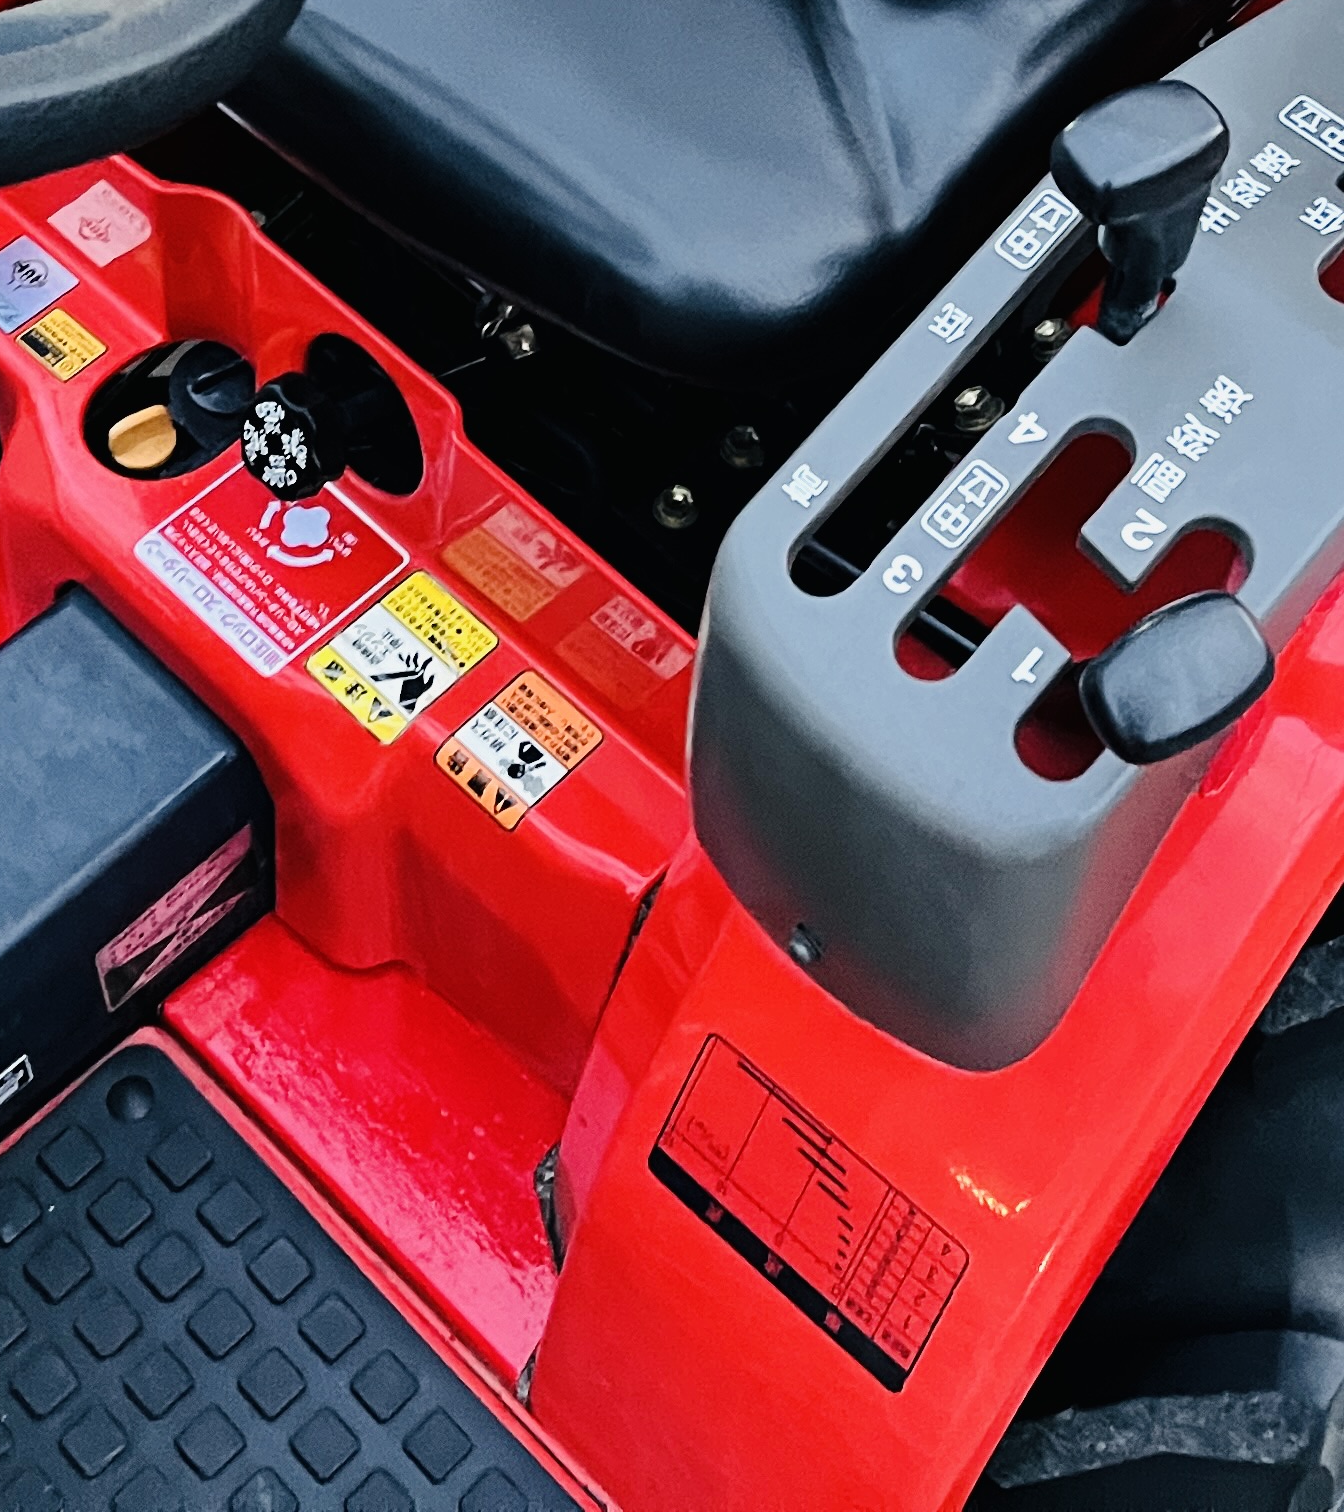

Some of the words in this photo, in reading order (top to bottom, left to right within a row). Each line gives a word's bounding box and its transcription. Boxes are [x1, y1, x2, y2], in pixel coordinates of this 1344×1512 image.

[1000, 192, 1073, 265] 中立
[929, 303, 972, 342] 低
[1009, 413, 1047, 443] 4
[1131, 376, 1253, 502] 副変速
[782, 464, 828, 507] 高
[926, 462, 1004, 542] 中立
[1122, 509, 1166, 549] 2
[883, 555, 922, 592] 3
[1012, 648, 1043, 682] 1
